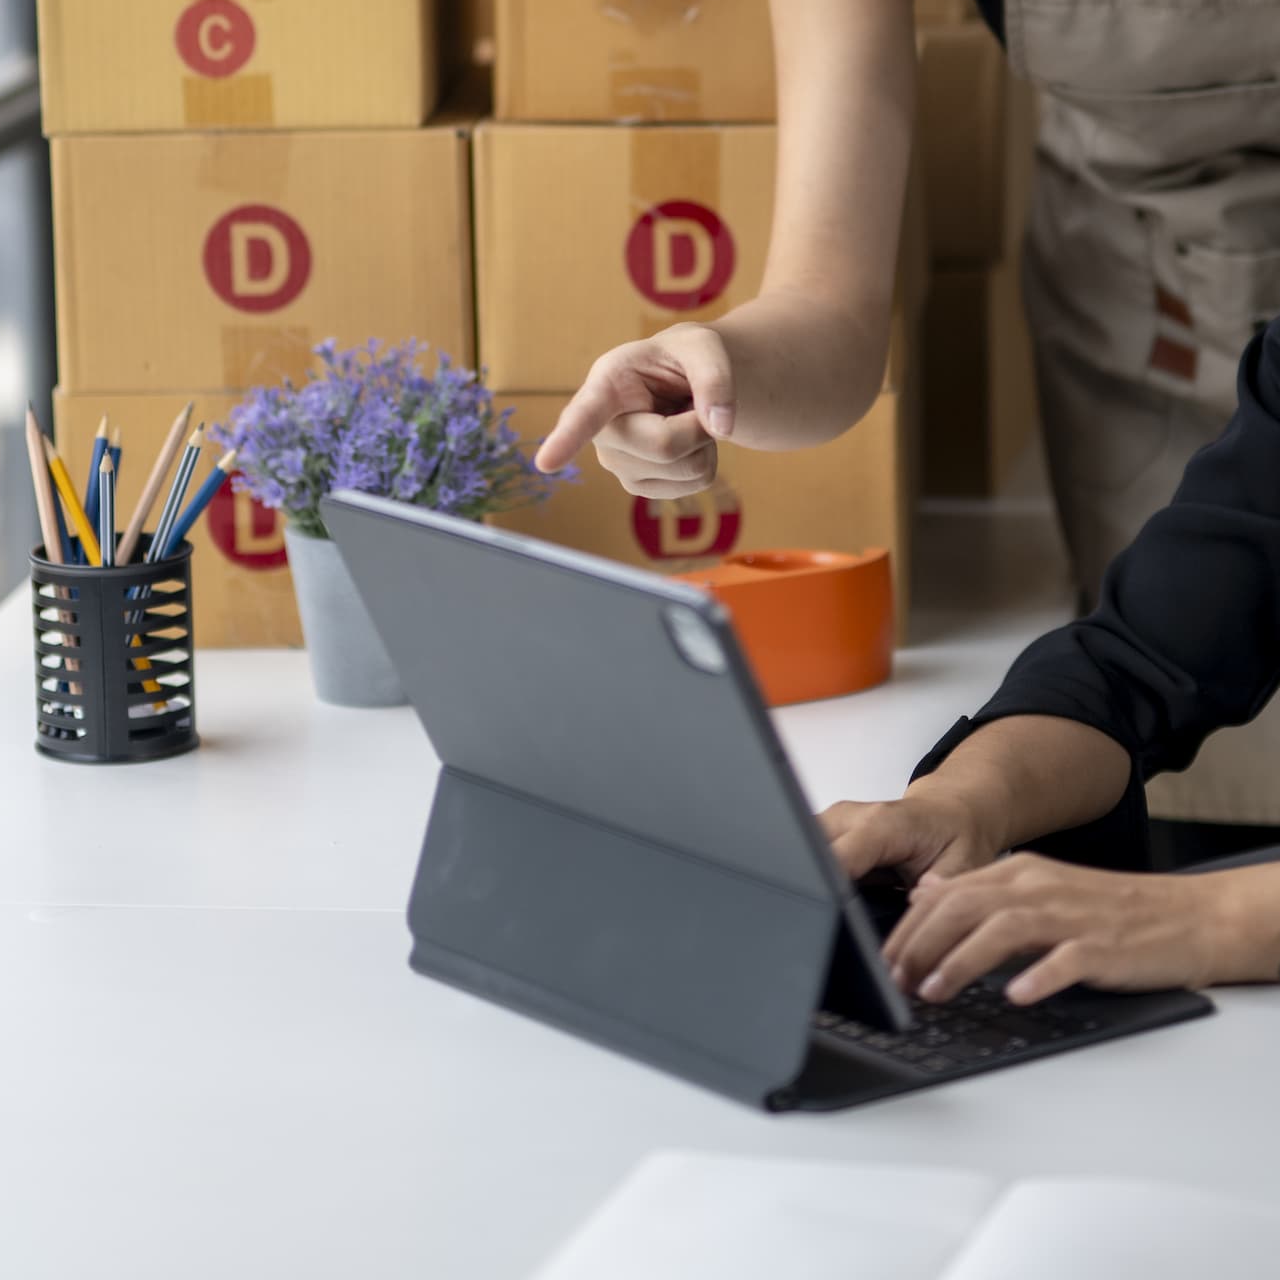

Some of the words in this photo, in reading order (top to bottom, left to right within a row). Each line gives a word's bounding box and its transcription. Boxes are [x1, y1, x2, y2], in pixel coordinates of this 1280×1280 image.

[198, 14, 233, 61] C
[231, 222, 289, 295] D
[653, 218, 714, 293] D
[660, 492, 718, 552] D
